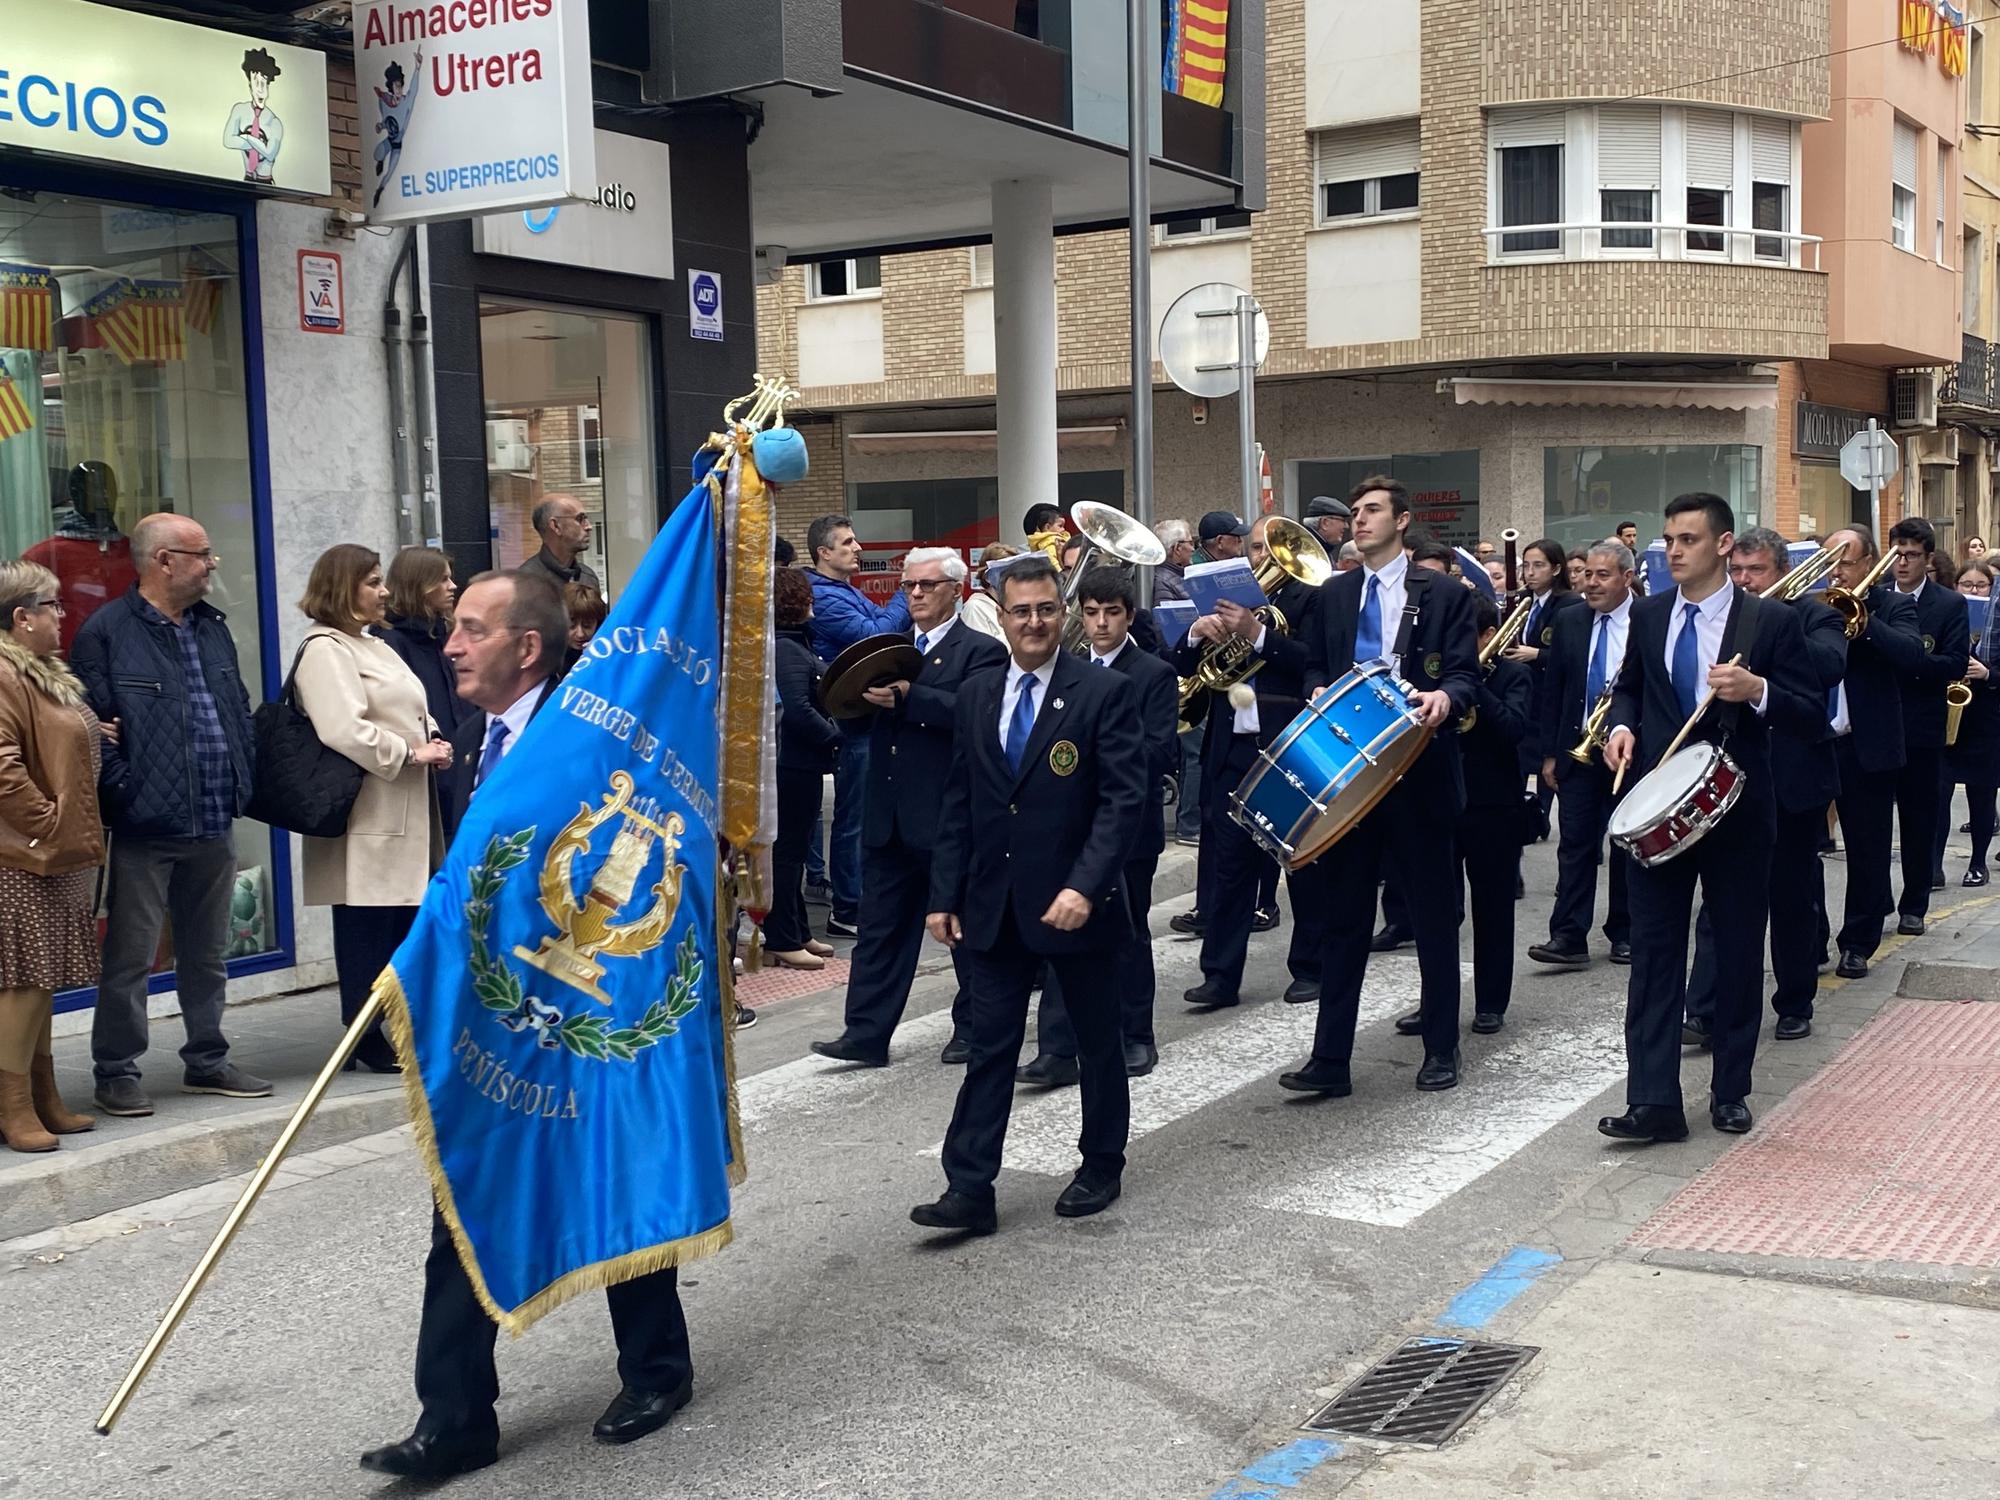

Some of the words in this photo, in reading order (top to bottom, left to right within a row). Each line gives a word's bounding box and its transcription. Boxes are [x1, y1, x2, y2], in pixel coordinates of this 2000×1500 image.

[432, 48, 542, 96] Utrera
[401, 175, 422, 197] EL
[425, 153, 559, 194] SUPERPRECIOS
[697, 287, 715, 303] ADT
[1803, 411, 1831, 446] MODA
[560, 686, 637, 741] VERGE
[631, 723, 660, 763] DE
[660, 747, 718, 841] L'ERMIT
[452, 1026, 579, 1119] PEÑÍSCOLA
